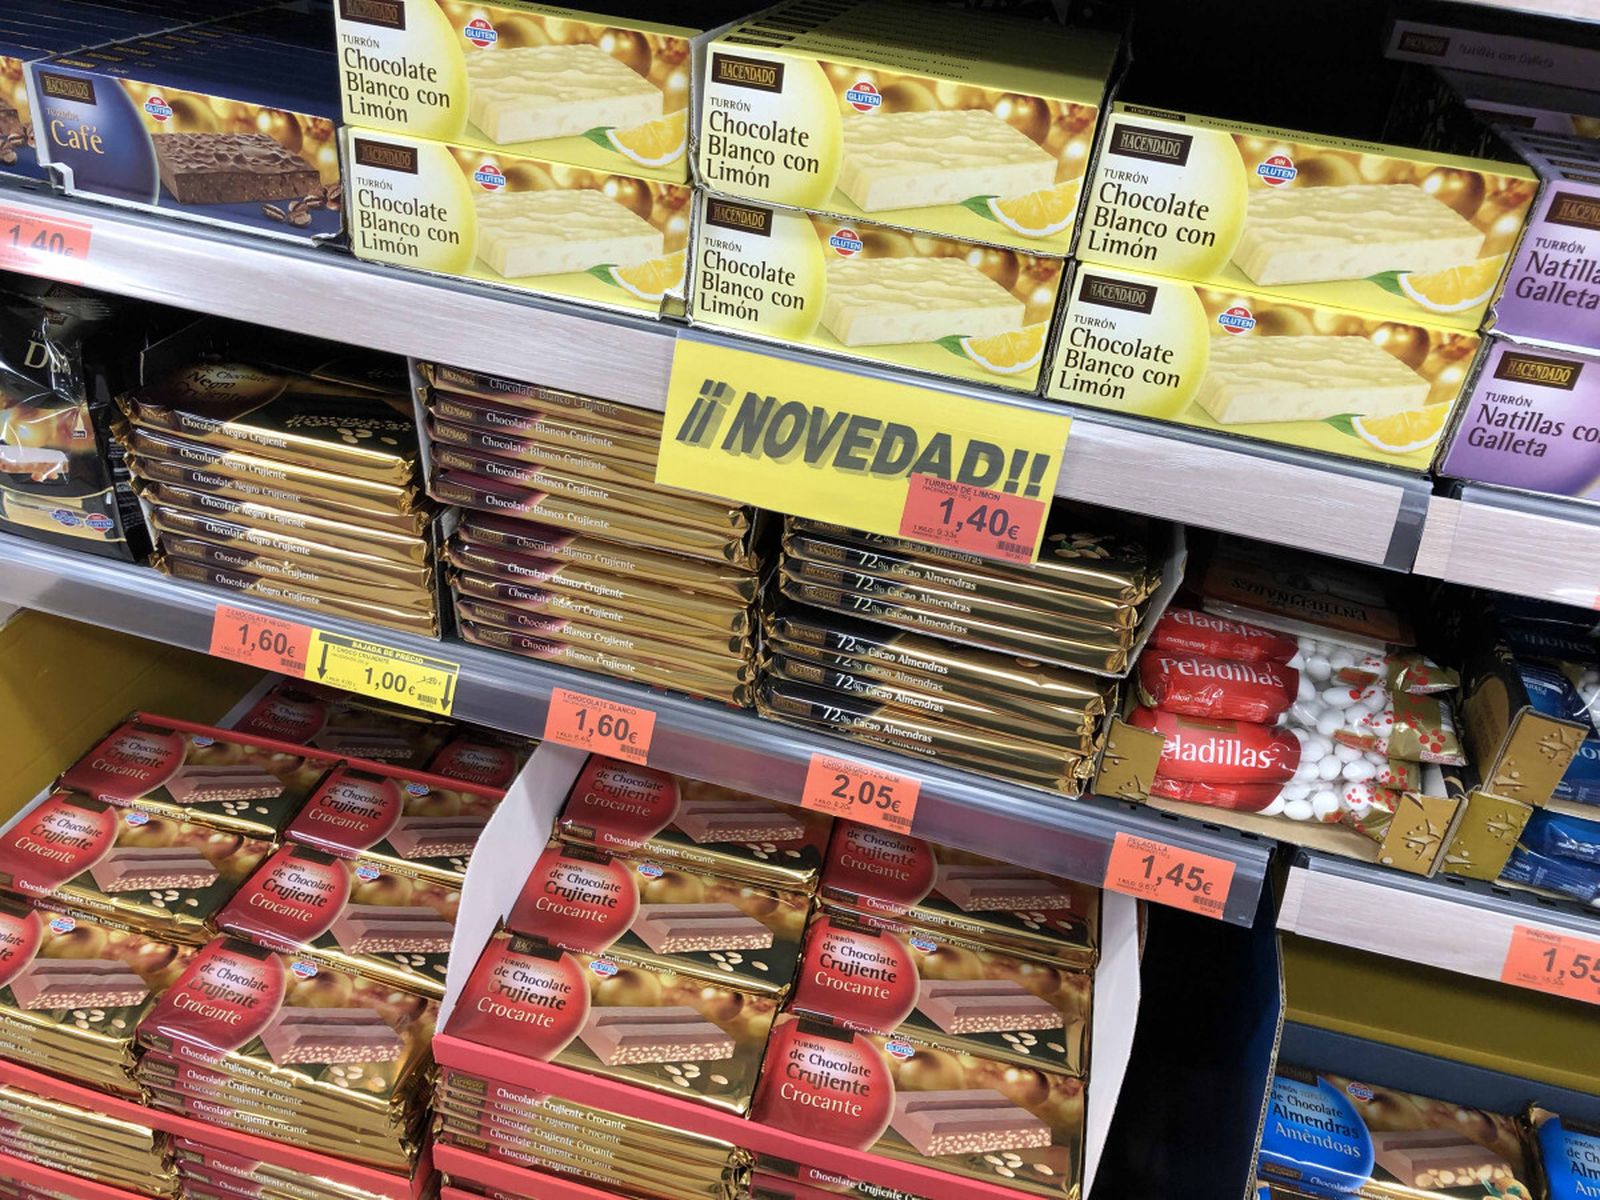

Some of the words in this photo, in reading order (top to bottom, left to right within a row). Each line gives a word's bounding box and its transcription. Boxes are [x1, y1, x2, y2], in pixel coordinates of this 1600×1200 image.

[342, 34, 380, 49] TURRÓN
[466, 28, 496, 41] GLUTEN
[344, 48, 437, 83] Chocolate
[720, 59, 776, 85] HACENDADO
[347, 71, 409, 100] Blanco
[417, 89, 450, 108] con
[710, 97, 751, 112] TURRÓN
[847, 91, 880, 105] GLUTEN
[348, 95, 408, 123] Limón
[51, 119, 104, 154] Café
[709, 111, 809, 148] Chocolate
[1121, 132, 1181, 157] HACENDADO
[708, 135, 775, 166] Blanco
[783, 154, 819, 174] con
[356, 177, 393, 191] TURRÓN
[475, 173, 504, 185] GLUTEN
[706, 157, 770, 189] Limón
[1104, 169, 1149, 185] TURRÓN
[1259, 165, 1295, 179] GLUTEN
[358, 189, 447, 222] Chocolate
[712, 205, 765, 229] HACENDADO
[1099, 182, 1209, 221] Chocolate
[360, 210, 420, 238] Blanco
[428, 227, 460, 245] con
[1094, 206, 1168, 238] Blanco
[1176, 225, 1215, 247] con
[361, 231, 418, 257] Limón
[704, 237, 742, 252] TURRÓN
[829, 237, 862, 252] GLUTEN
[1088, 231, 1158, 261] Limón
[1536, 238, 1586, 254] TURRÓN
[703, 250, 796, 287] Chocolate
[702, 271, 764, 302] Blanco
[771, 289, 805, 311] con
[1090, 282, 1146, 305] HACENDADO
[1516, 277, 1600, 310] Galleta
[700, 293, 758, 322] Limón
[1074, 314, 1117, 330] TURRÓN
[1219, 315, 1253, 328] GLUTEN
[1070, 328, 1174, 365] Chocolate
[1064, 349, 1134, 379] Blanco
[1142, 369, 1180, 388] con
[1507, 360, 1572, 383] HACENDADO
[1059, 370, 1125, 400] Limón
[1486, 392, 1533, 408] TURRÓN
[182, 417, 221, 434] Chocolate
[222, 426, 247, 440] Negro
[250, 432, 288, 448] Crujiente
[486, 413, 532, 430] Chocolate
[535, 422, 567, 439] Blanco
[569, 429, 613, 448] Crujiente
[1477, 404, 1566, 436] Natillas
[1468, 427, 1548, 458] Galleta
[180, 448, 219, 466] Chocolate
[220, 457, 246, 472] Negro
[249, 464, 286, 480] Crujiente
[923, 478, 959, 493] TURRON
[960, 486, 971, 494] DE
[973, 490, 1000, 501] LIMON
[485, 495, 530, 514] Chocolate
[533, 506, 564, 521] Blanco
[567, 513, 610, 530] Crujiente
[940, 497, 1020, 540] 1,40€
[856, 551, 889, 572] 72%
[892, 563, 921, 580] Cacao
[924, 571, 976, 592] Almendras
[215, 574, 254, 590] Chocolate
[256, 583, 281, 597] Negro
[283, 590, 320, 605] Crujiente
[854, 574, 885, 594] 72%
[887, 586, 916, 602] Cacao
[919, 593, 972, 614] Almendras
[239, 624, 295, 657] 1,60€
[352, 641, 381, 654] BAJADA
[396, 652, 423, 664] PRECIO
[521, 639, 563, 656] Chocolate
[566, 648, 594, 663] Blanco
[597, 656, 636, 673] Crujiente
[1159, 658, 1283, 688] Peladillas
[576, 709, 638, 744] 1,60€
[822, 705, 851, 725] 72%
[853, 716, 881, 733] Cacao
[882, 723, 933, 744] Almendras
[1162, 734, 1277, 769] eladillas
[832, 774, 901, 812] 2,05€
[30, 824, 93, 850] Crujiente
[42, 813, 56, 824] de
[57, 817, 103, 838] Chocolate
[15, 836, 75, 864] Crocante
[604, 832, 642, 849] Chocolate
[643, 842, 679, 858] Crujiente
[680, 850, 716, 865] Crocante
[272, 867, 286, 878] de
[287, 871, 336, 893] Chocolate
[549, 869, 564, 880] de
[566, 872, 622, 894] Chocolate
[1142, 855, 1214, 895] 1,45€
[249, 892, 313, 922] Crocante
[262, 878, 328, 908] Crujiente
[543, 881, 618, 909] Crujiente
[535, 897, 608, 923] Crocante
[819, 953, 897, 984] Crujiente
[823, 942, 837, 952] de
[840, 945, 898, 967] Chocolate
[186, 976, 259, 1009] Crujiente
[200, 963, 214, 975] de
[216, 967, 269, 992] Chocolate
[494, 966, 509, 977] de
[512, 970, 572, 994] Chocolate
[814, 972, 891, 1000] Crocante
[173, 992, 242, 1026] Crocante
[487, 979, 567, 1011] Crujiente
[477, 996, 554, 1029] Crocante
[180, 1046, 219, 1064] Chocolate
[220, 1058, 256, 1079] Crujiente
[257, 1071, 292, 1089] Crocante
[789, 1049, 805, 1061] de
[808, 1053, 872, 1078] Chocolate
[785, 1062, 870, 1097] Crujiente
[496, 1087, 541, 1106] Chocolate
[543, 1100, 585, 1120] Crujiente
[586, 1111, 627, 1130] Crocante
[780, 1082, 863, 1118] Crocante
[1271, 1090, 1284, 1100] de
[1287, 1095, 1344, 1118] Chocolate
[1273, 1103, 1360, 1139] Almendras
[1276, 1121, 1361, 1157] Amêndoas
